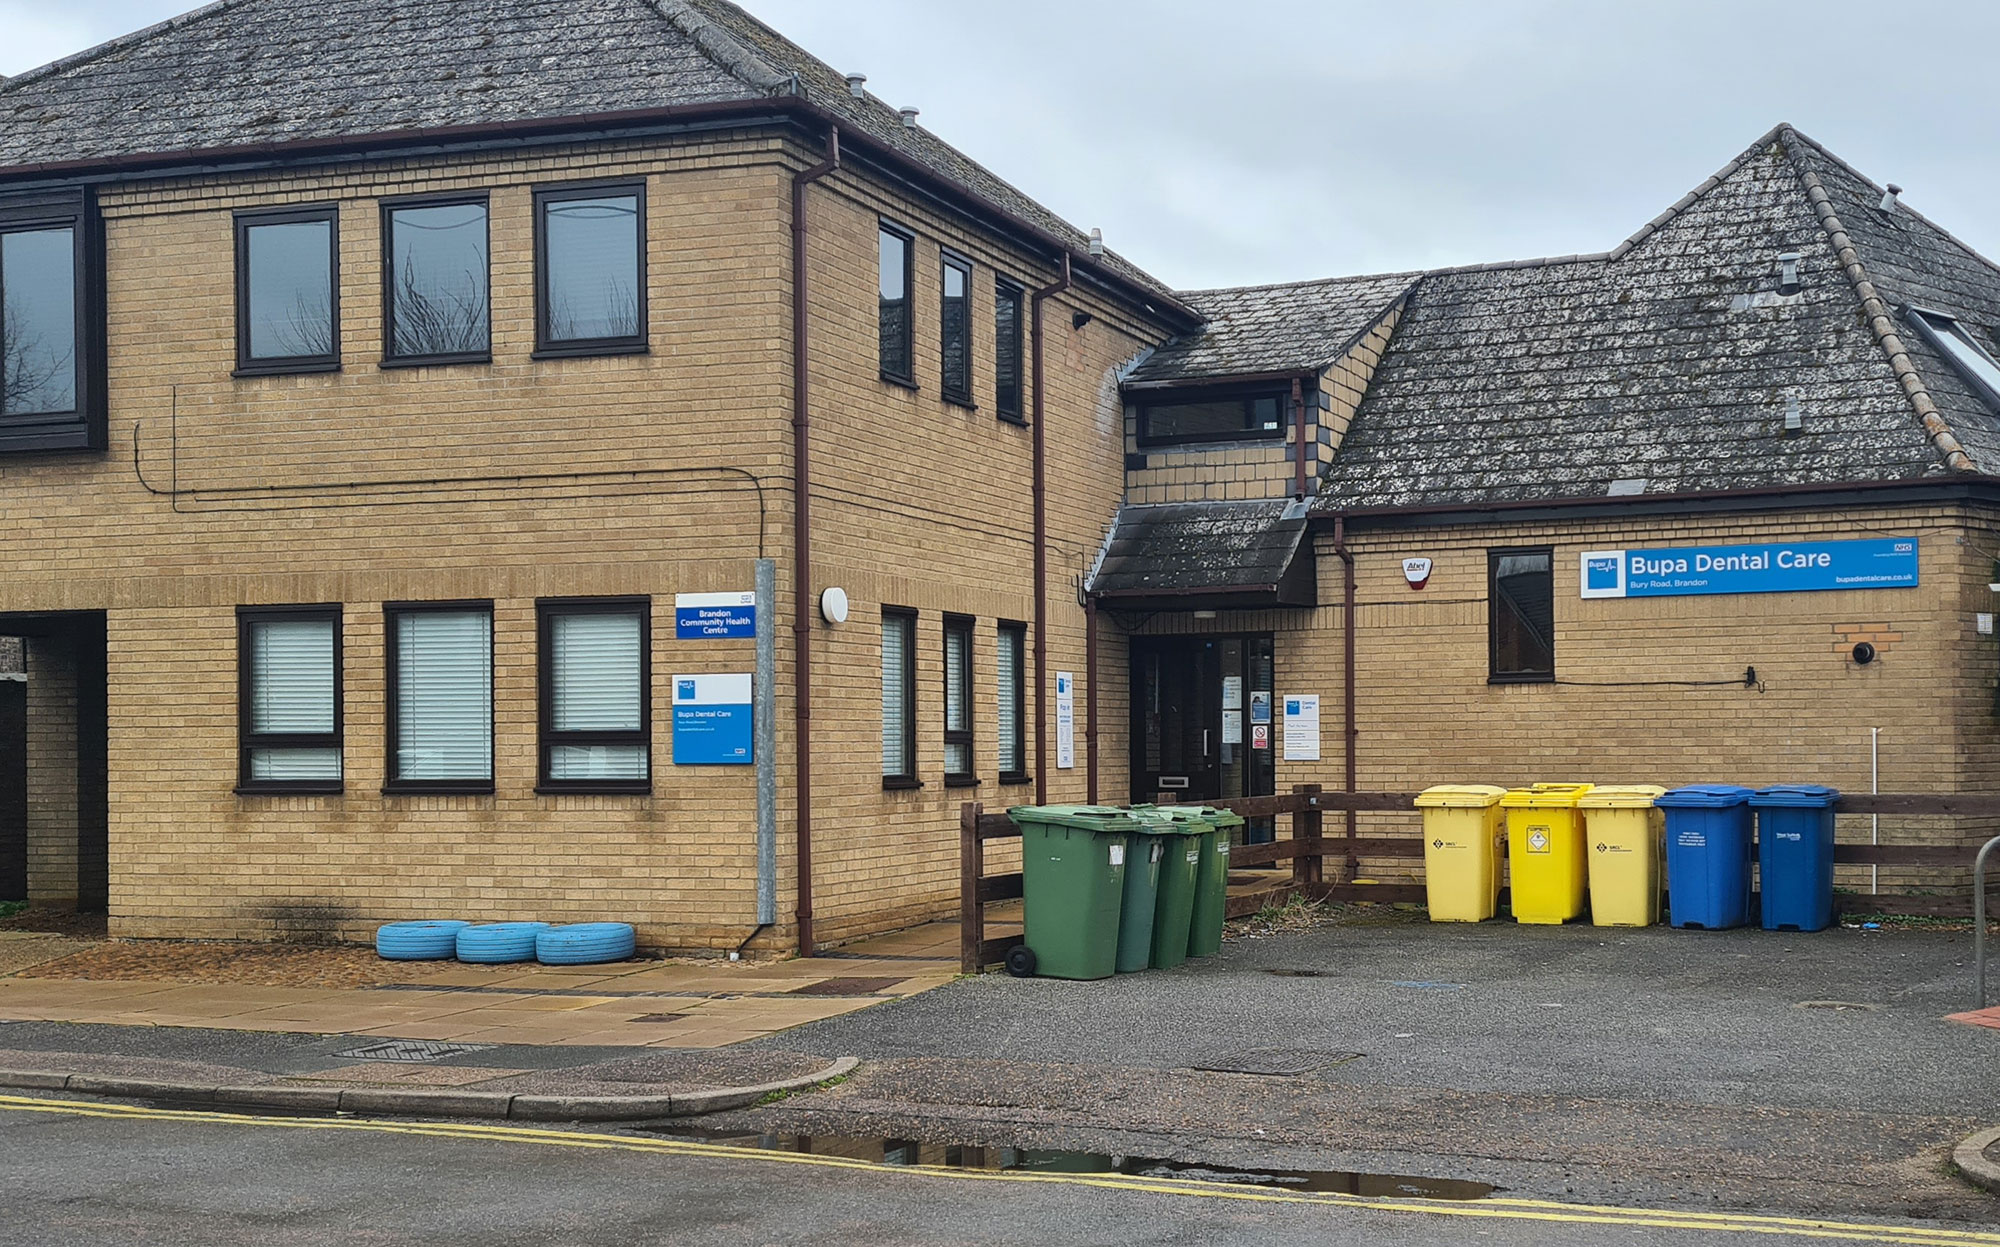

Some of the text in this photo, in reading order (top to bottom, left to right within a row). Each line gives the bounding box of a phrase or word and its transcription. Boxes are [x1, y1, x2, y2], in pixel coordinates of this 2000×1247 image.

[1631, 550, 1831, 576] Bupa Dental Care
[1836, 574, 1912, 583] bupadentalcare.co.uk
[1630, 581, 1648, 589] Bury
[1674, 579, 1708, 587] Brandon
[699, 610, 731, 618] Brandon
[680, 617, 751, 627] Community Health
[703, 626, 728, 634] Centre
